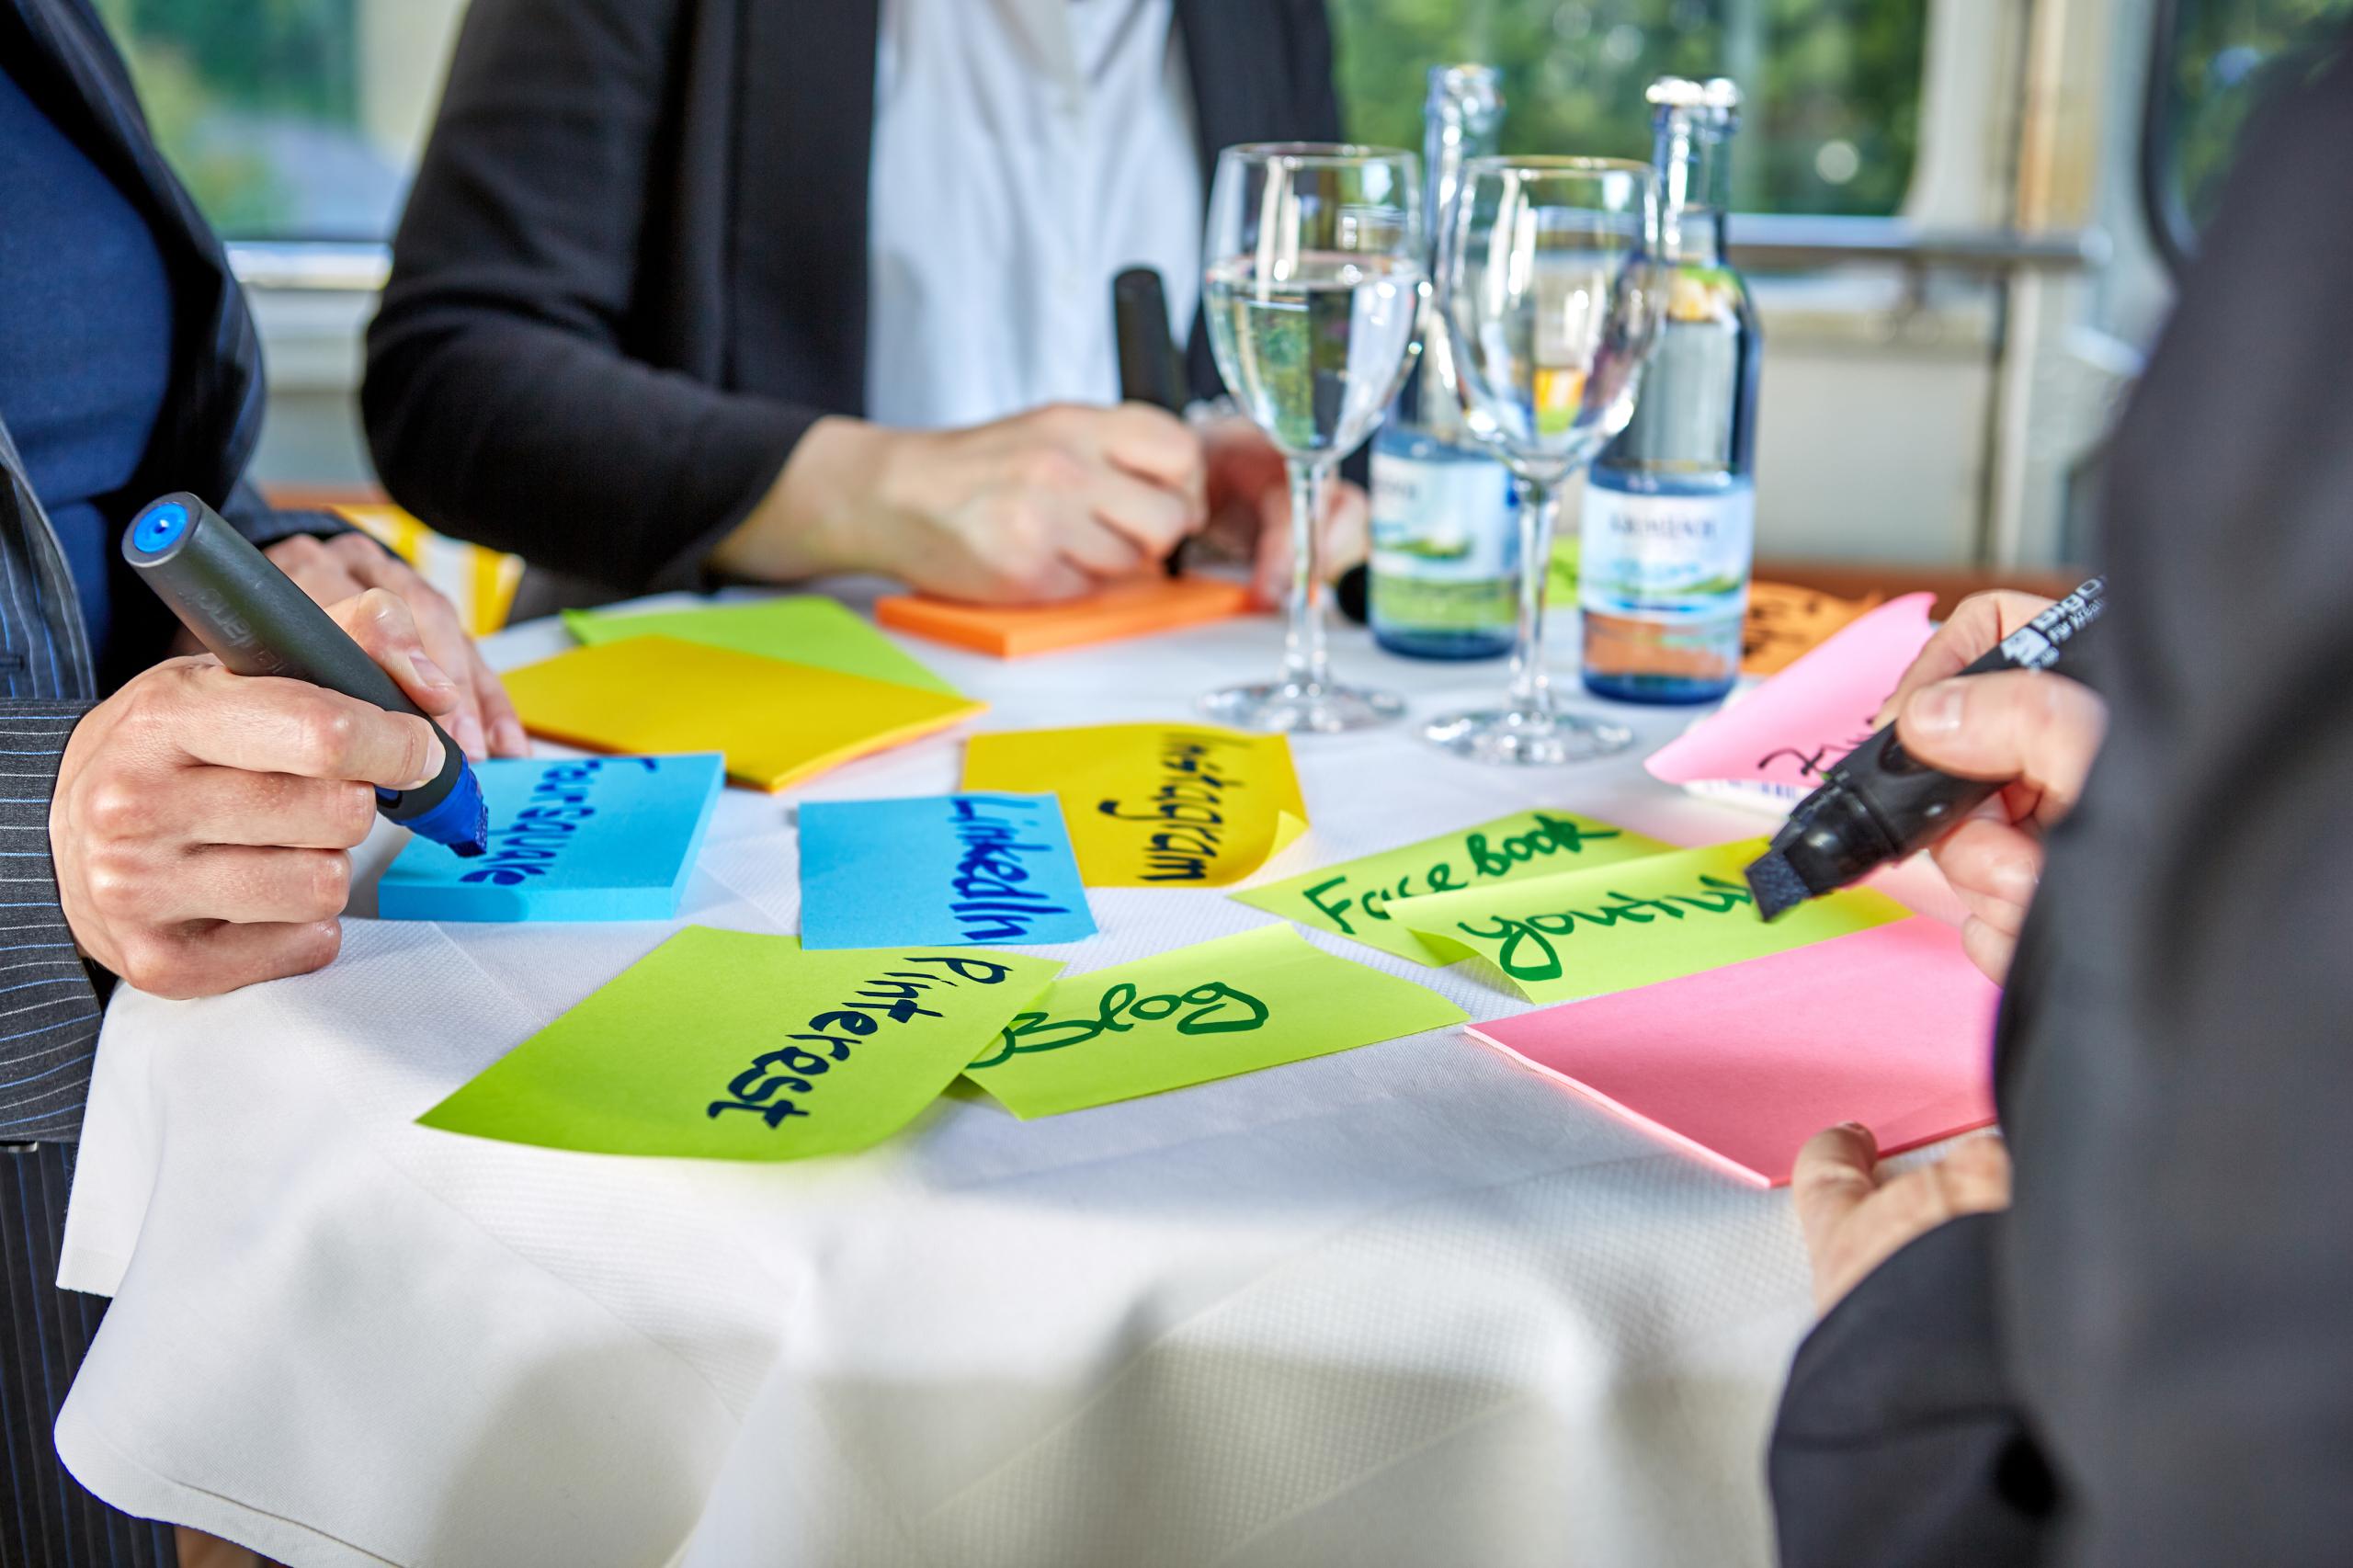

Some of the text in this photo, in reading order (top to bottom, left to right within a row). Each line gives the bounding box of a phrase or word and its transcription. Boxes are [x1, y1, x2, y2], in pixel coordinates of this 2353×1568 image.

[948, 797, 1072, 941] LinkedIn
[1097, 733, 1253, 881] Instagram
[706, 956, 1015, 1130] Pinterest
[965, 981, 1269, 1070] Blog
